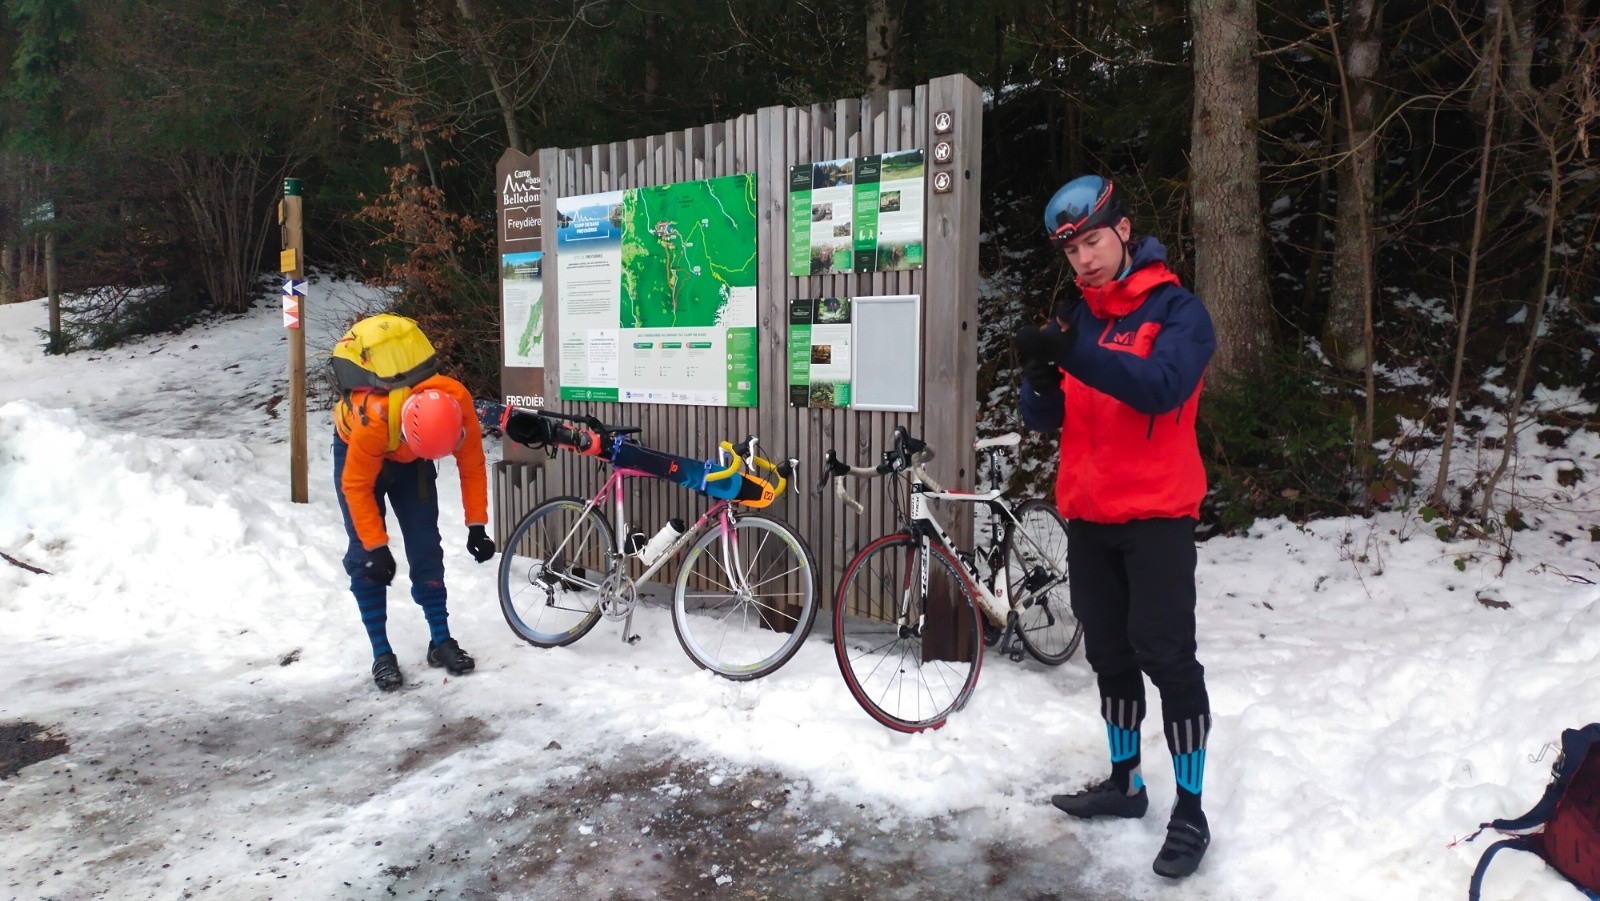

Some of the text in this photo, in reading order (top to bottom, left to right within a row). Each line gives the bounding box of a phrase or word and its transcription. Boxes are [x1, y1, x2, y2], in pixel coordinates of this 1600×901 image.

[514, 170, 531, 178] Camp
[503, 192, 541, 206] Belledon
[506, 394, 544, 407] FREYDIÈR
